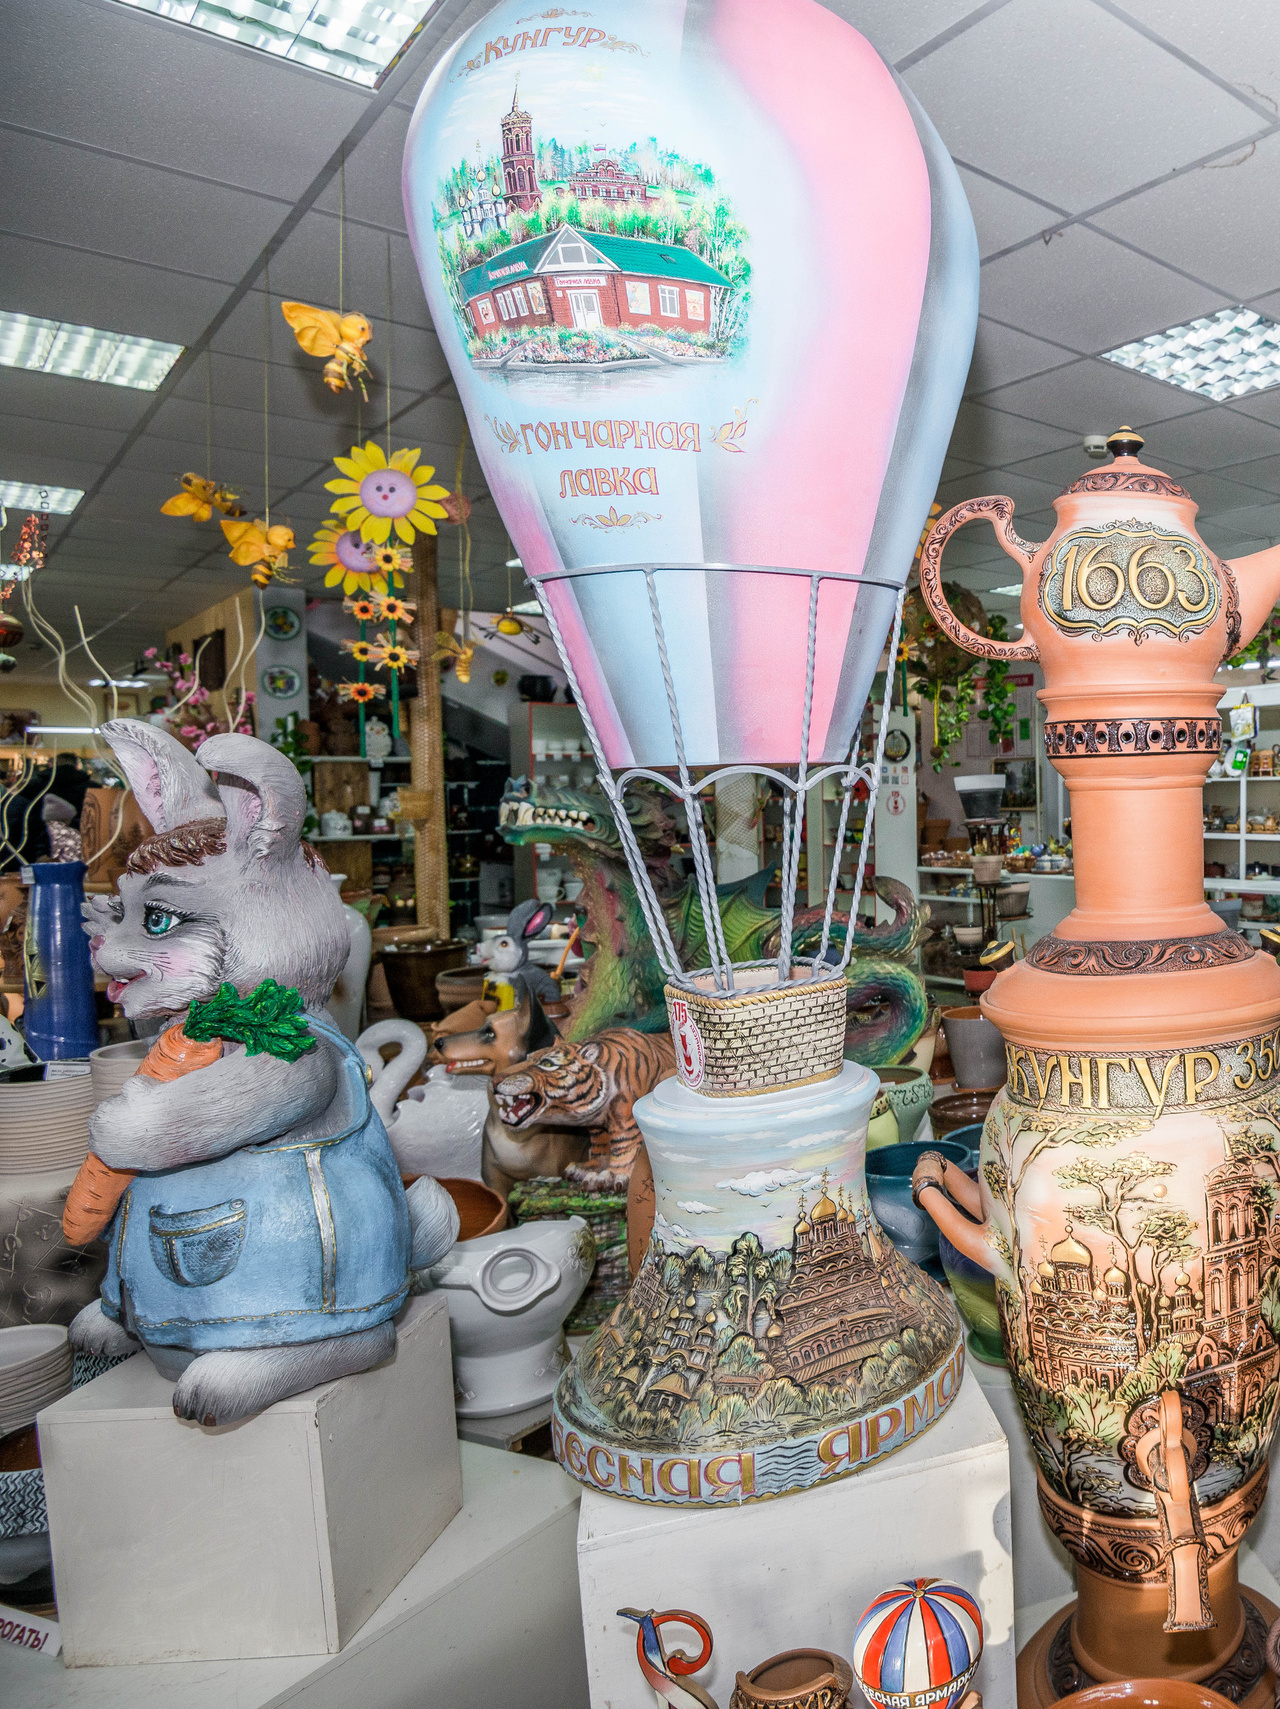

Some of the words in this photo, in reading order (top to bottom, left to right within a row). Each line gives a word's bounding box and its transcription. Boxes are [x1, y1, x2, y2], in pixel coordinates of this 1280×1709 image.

[484, 26, 606, 65] КУНГУР
[520, 420, 701, 454] ГОНЧАРНАЯ
[559, 467, 659, 498] ЛАВКА
[1059, 543, 1209, 612] 1663
[673, 1001, 688, 1024] 175
[1234, 1028, 1280, 1090] 350
[817, 1341, 965, 1476] ЯРМАР
